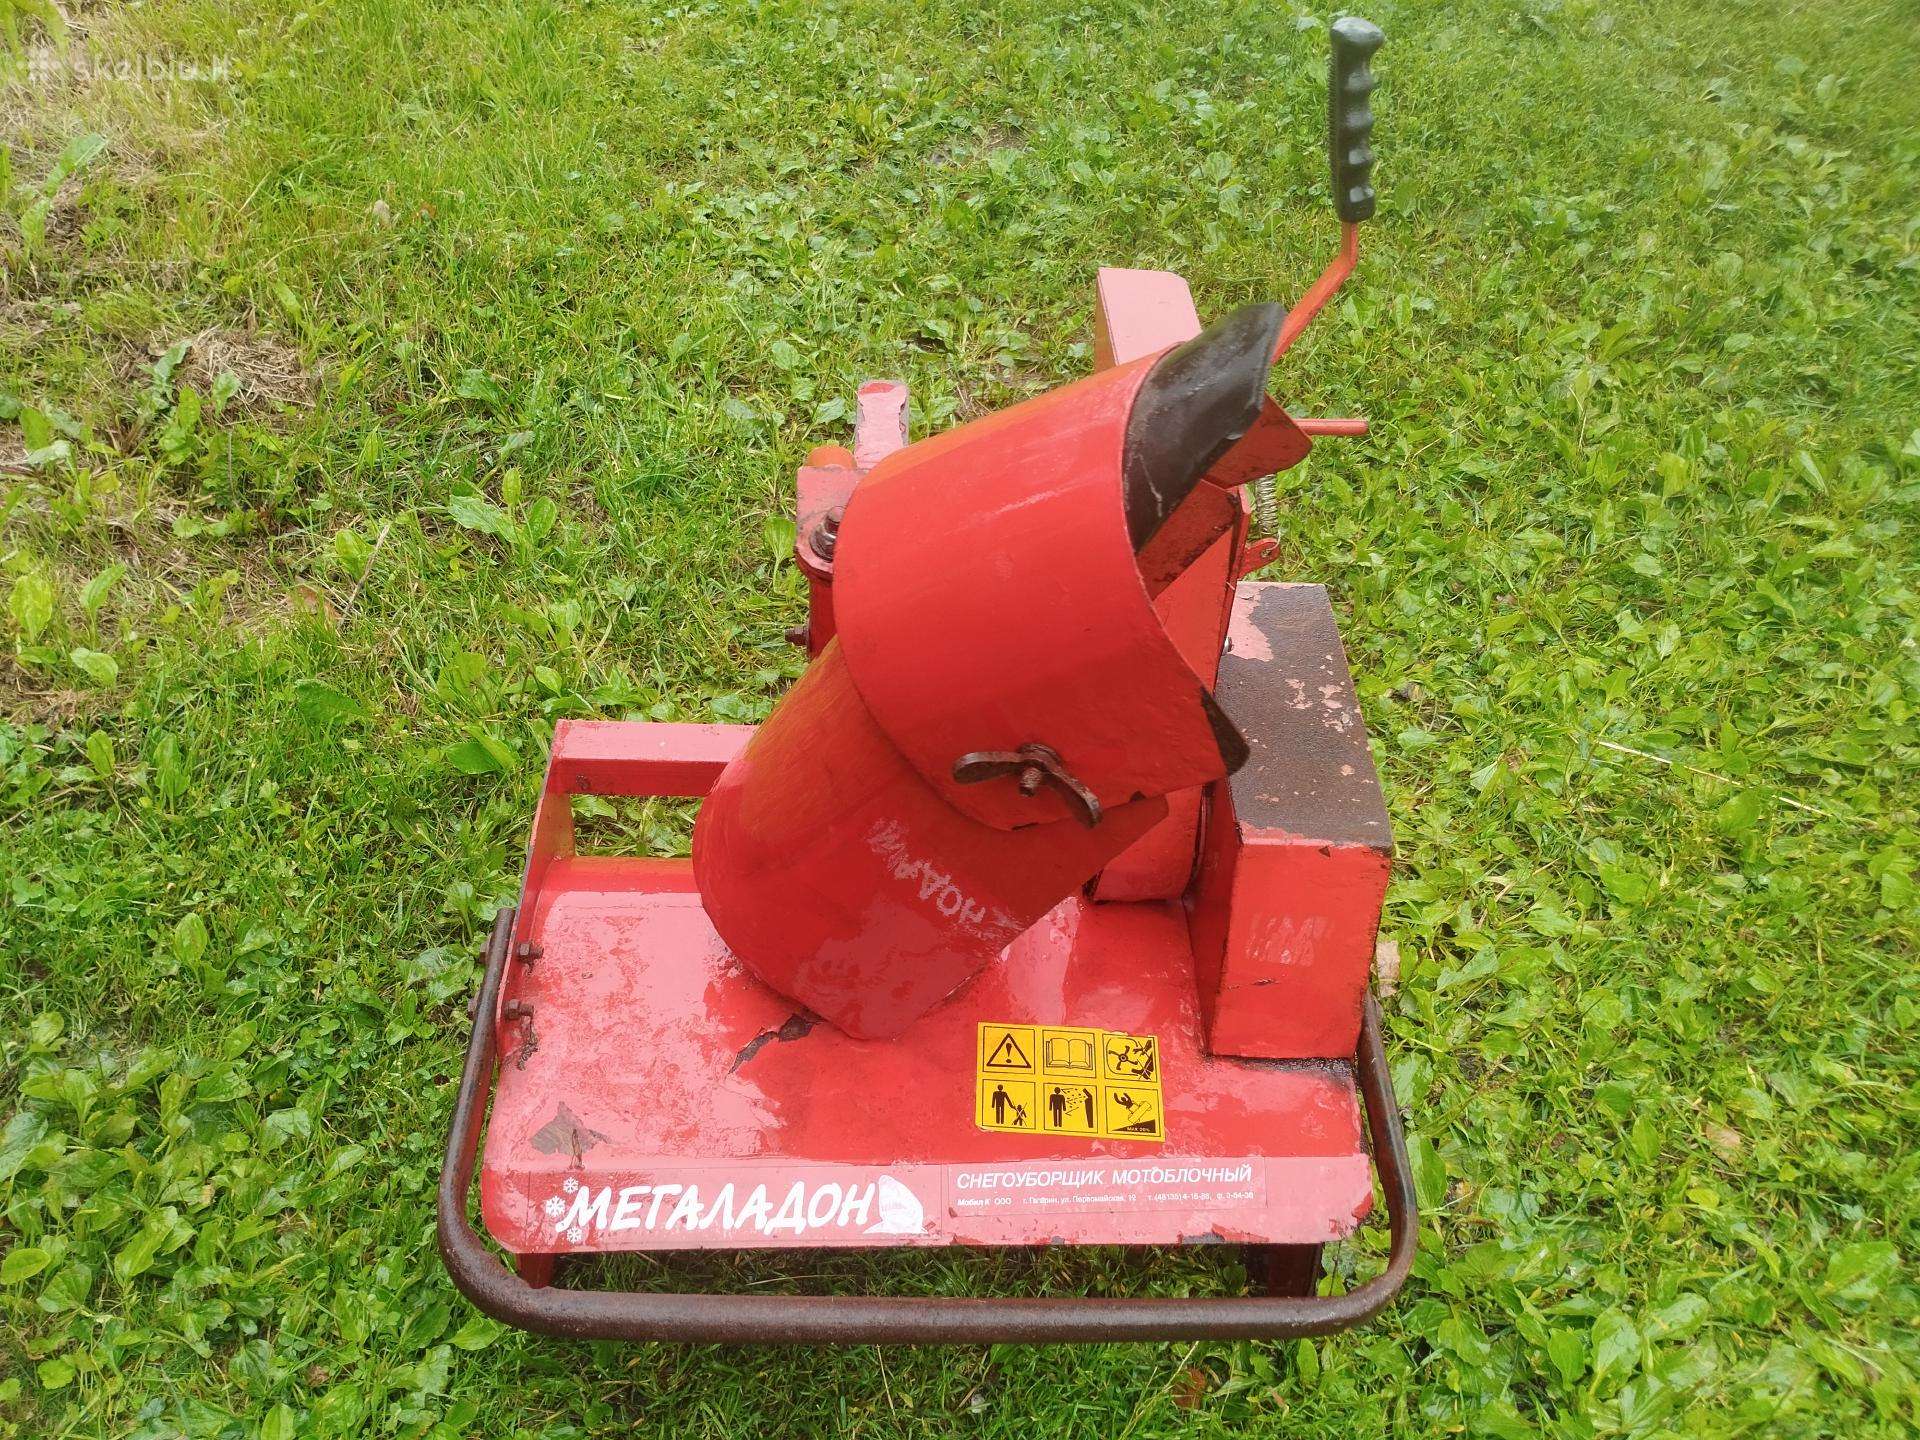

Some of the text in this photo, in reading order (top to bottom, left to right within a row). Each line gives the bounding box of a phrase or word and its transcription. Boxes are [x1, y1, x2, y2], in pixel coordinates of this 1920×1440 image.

[956, 1163, 1253, 1189] СНЕГОУБОРЩИК МОТОБЛОЧНЫЙ
[555, 1181, 876, 1235] МЕГАЛАДОН
